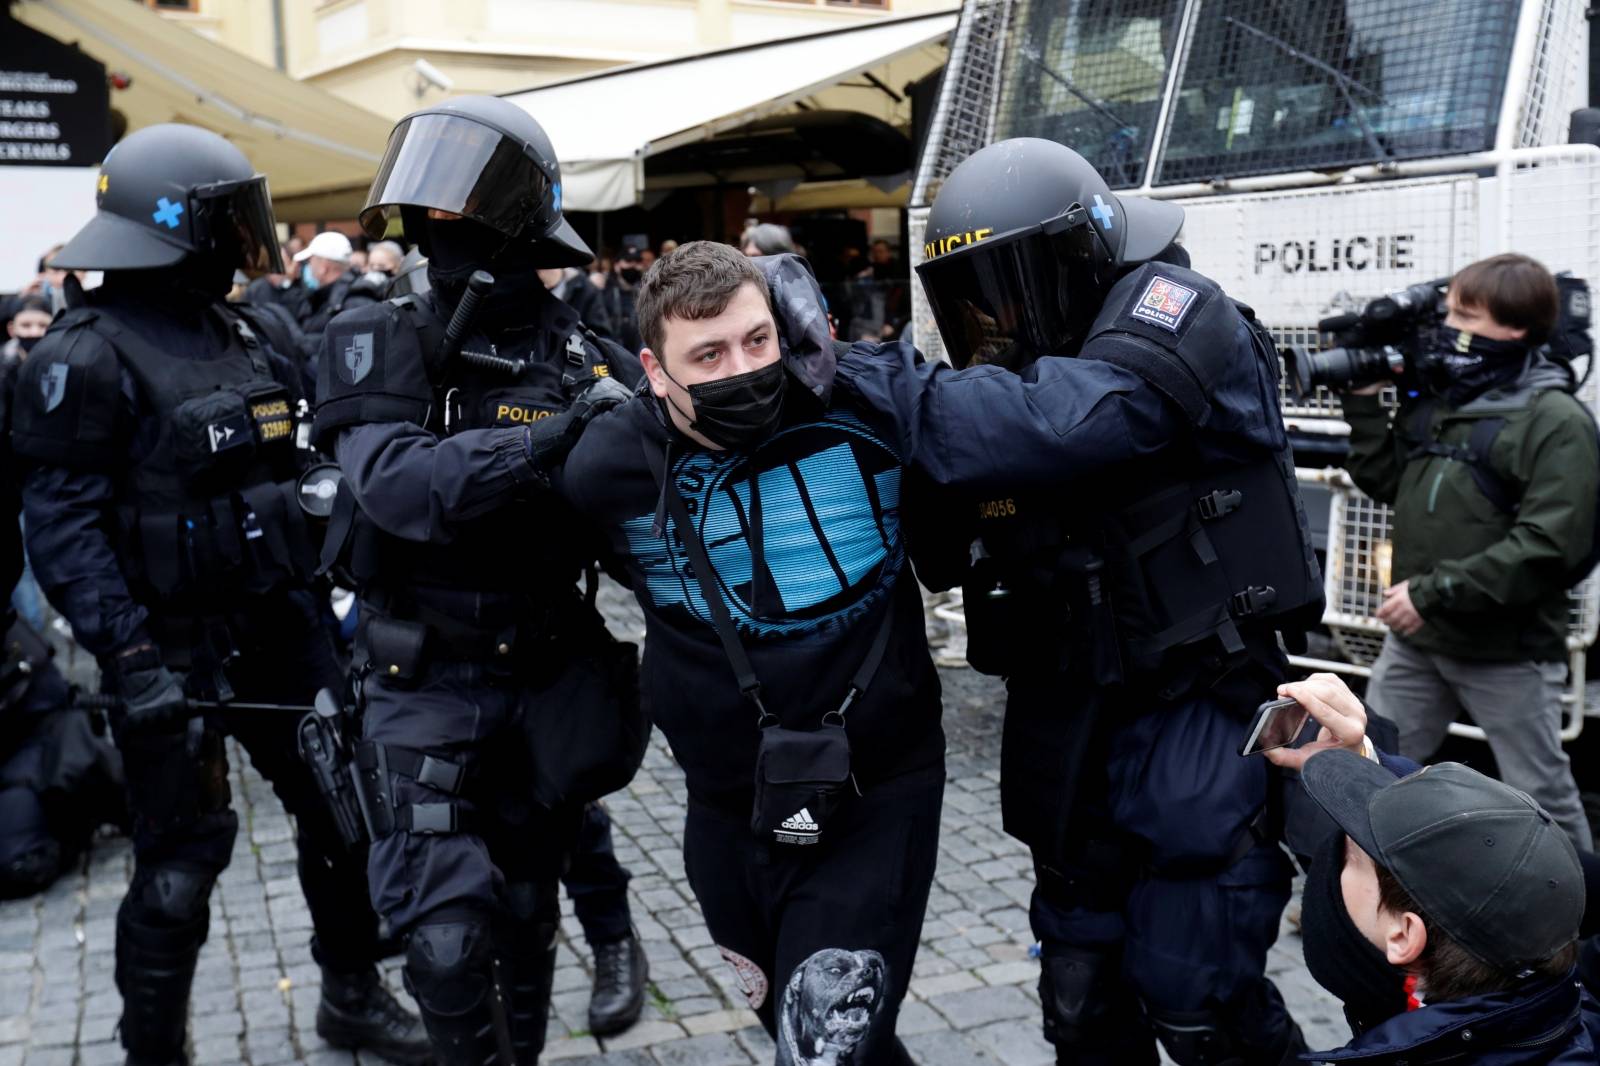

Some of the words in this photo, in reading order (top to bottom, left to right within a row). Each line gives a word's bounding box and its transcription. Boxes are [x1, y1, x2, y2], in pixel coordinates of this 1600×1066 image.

[0, 100, 50, 118] EAKS
[1254, 234, 1414, 275] POLICIE
[1138, 307, 1175, 324] POLICIE
[497, 405, 561, 423] POLIC
[978, 498, 1016, 519] 4056
[781, 821, 819, 831] adidas
